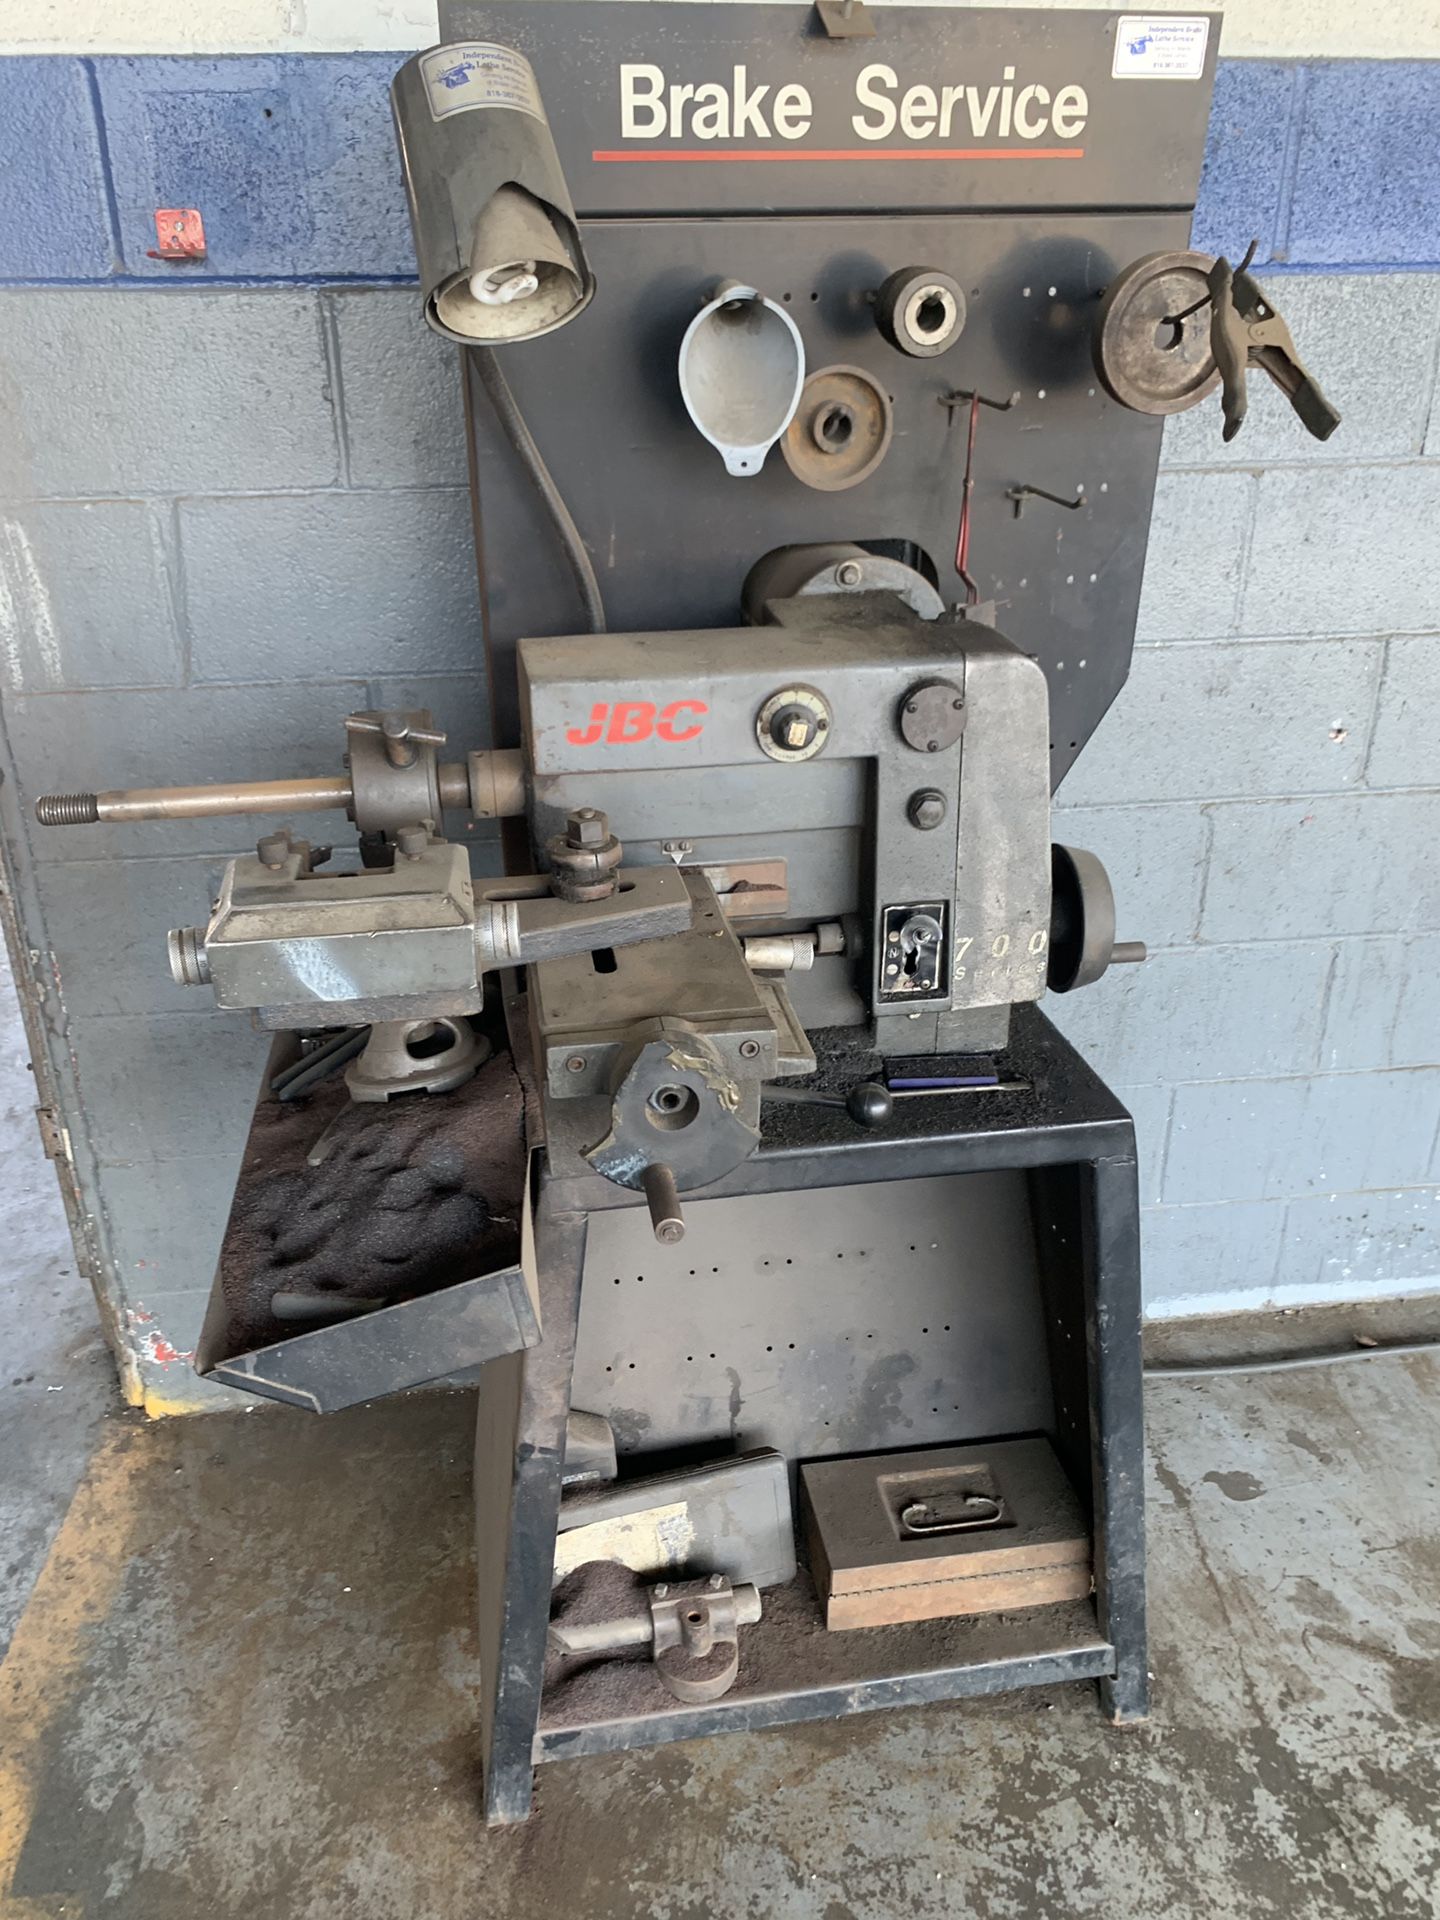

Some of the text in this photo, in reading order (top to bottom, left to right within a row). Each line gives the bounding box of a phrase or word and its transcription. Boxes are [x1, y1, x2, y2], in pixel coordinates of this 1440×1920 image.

[619, 64, 1089, 140] Brake Service
[565, 699, 709, 746] JBC
[955, 929, 1048, 962] 700
